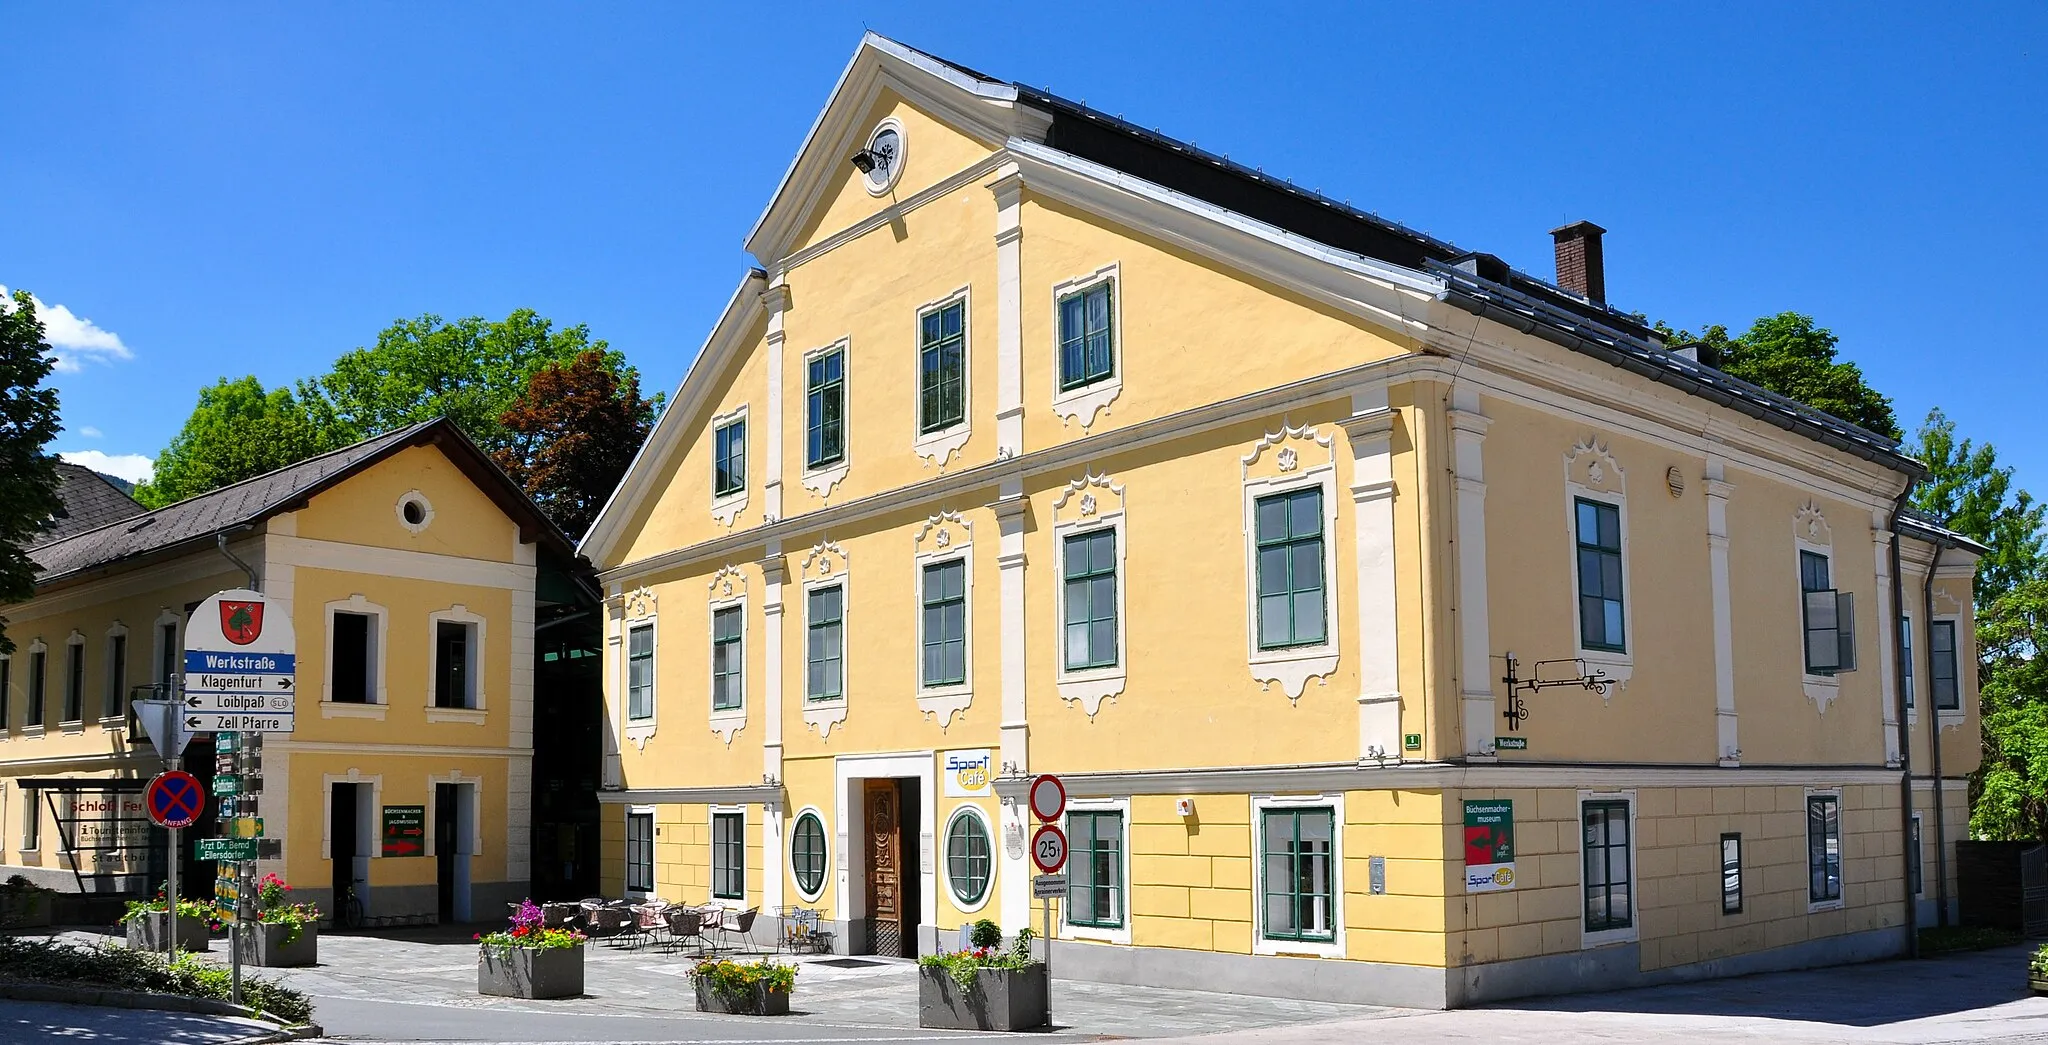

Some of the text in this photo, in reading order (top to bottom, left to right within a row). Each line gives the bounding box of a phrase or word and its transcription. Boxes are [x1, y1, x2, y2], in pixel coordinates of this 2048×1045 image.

[206, 655, 276, 670] Werkstraße
[201, 674, 262, 691] Klagenfurt
[217, 695, 265, 711] Loiblpaß
[217, 716, 279, 729] Zell Pfarre
[1410, 736, 1415, 744] 1
[946, 755, 990, 774] Sport
[962, 770, 986, 786] Café
[1466, 804, 1511, 814] Büchsenmacher-
[162, 816, 192, 827] ANFANG
[1477, 815, 1502, 823] museum
[200, 841, 250, 850] Arzt Dr. Bernd
[204, 850, 245, 859] Ellersdorfer
[1468, 870, 1512, 887] Sport Café
